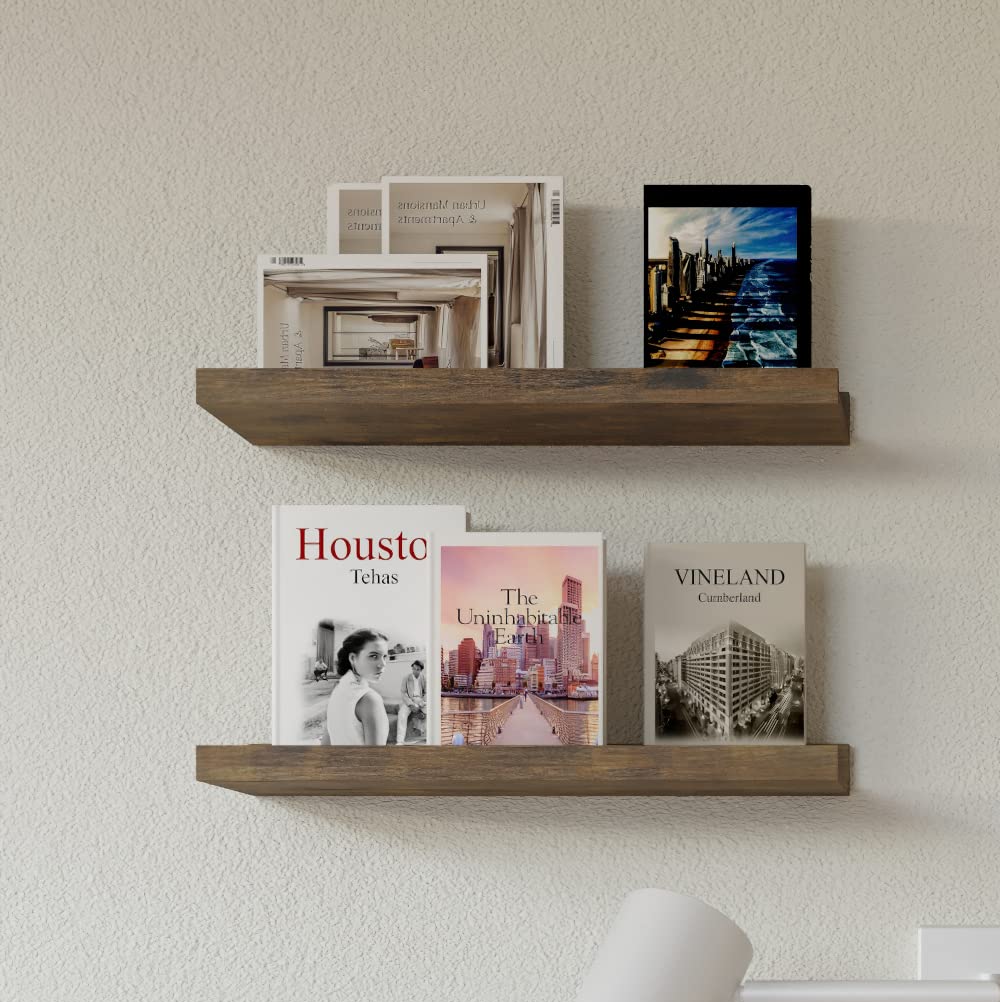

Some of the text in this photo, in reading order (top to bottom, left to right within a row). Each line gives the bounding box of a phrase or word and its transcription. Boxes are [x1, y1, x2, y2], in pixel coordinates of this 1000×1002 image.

[295, 527, 427, 561] Housto
[349, 568, 399, 585] Tehas
[674, 567, 786, 586] VINELAND
[500, 588, 539, 606] The
[697, 592, 762, 604] Cumberland
[456, 607, 583, 626] Uninhabitable
[494, 627, 544, 646] Earth
